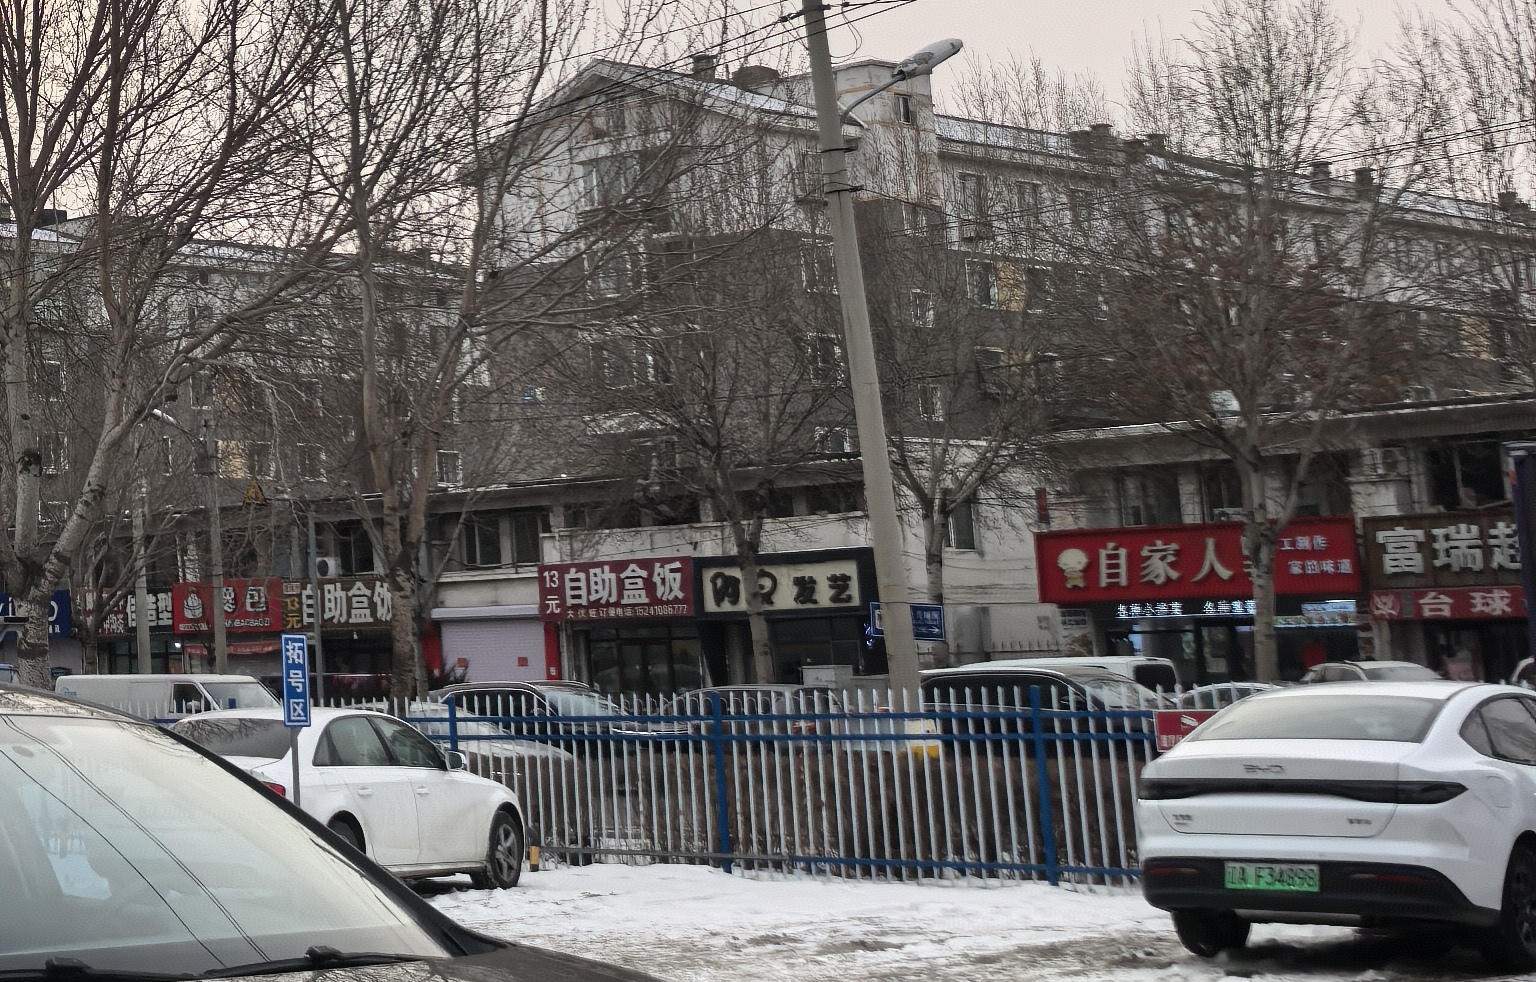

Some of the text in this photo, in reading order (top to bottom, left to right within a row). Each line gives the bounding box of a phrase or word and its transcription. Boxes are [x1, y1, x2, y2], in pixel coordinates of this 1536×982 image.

[564, 561, 685, 606] 自助盒饭
[1418, 589, 1513, 617] 台球
[285, 641, 306, 720] 拓号区
